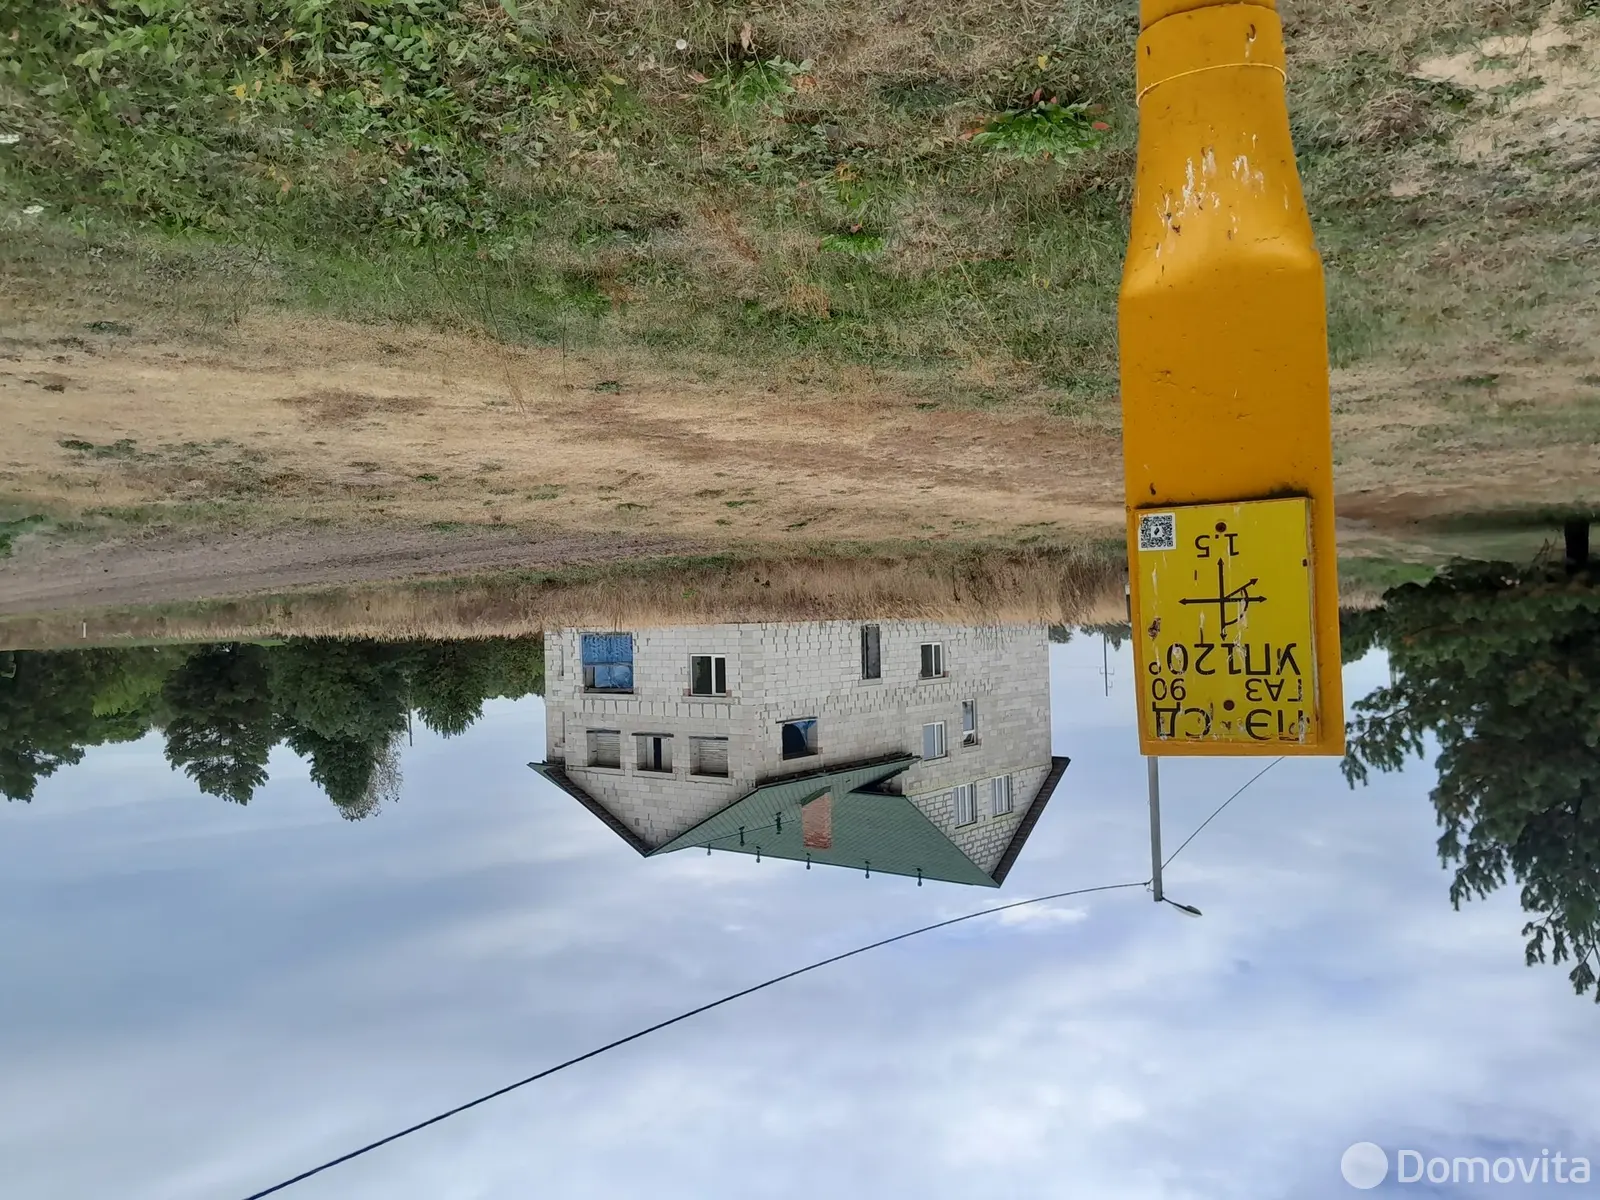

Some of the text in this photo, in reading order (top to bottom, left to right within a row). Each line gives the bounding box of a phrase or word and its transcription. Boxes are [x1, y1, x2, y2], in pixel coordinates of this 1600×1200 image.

[1194, 533, 1240, 559] 1.5
[1151, 678, 1303, 702] ГАЗ 90
[1152, 701, 1211, 739] СД
